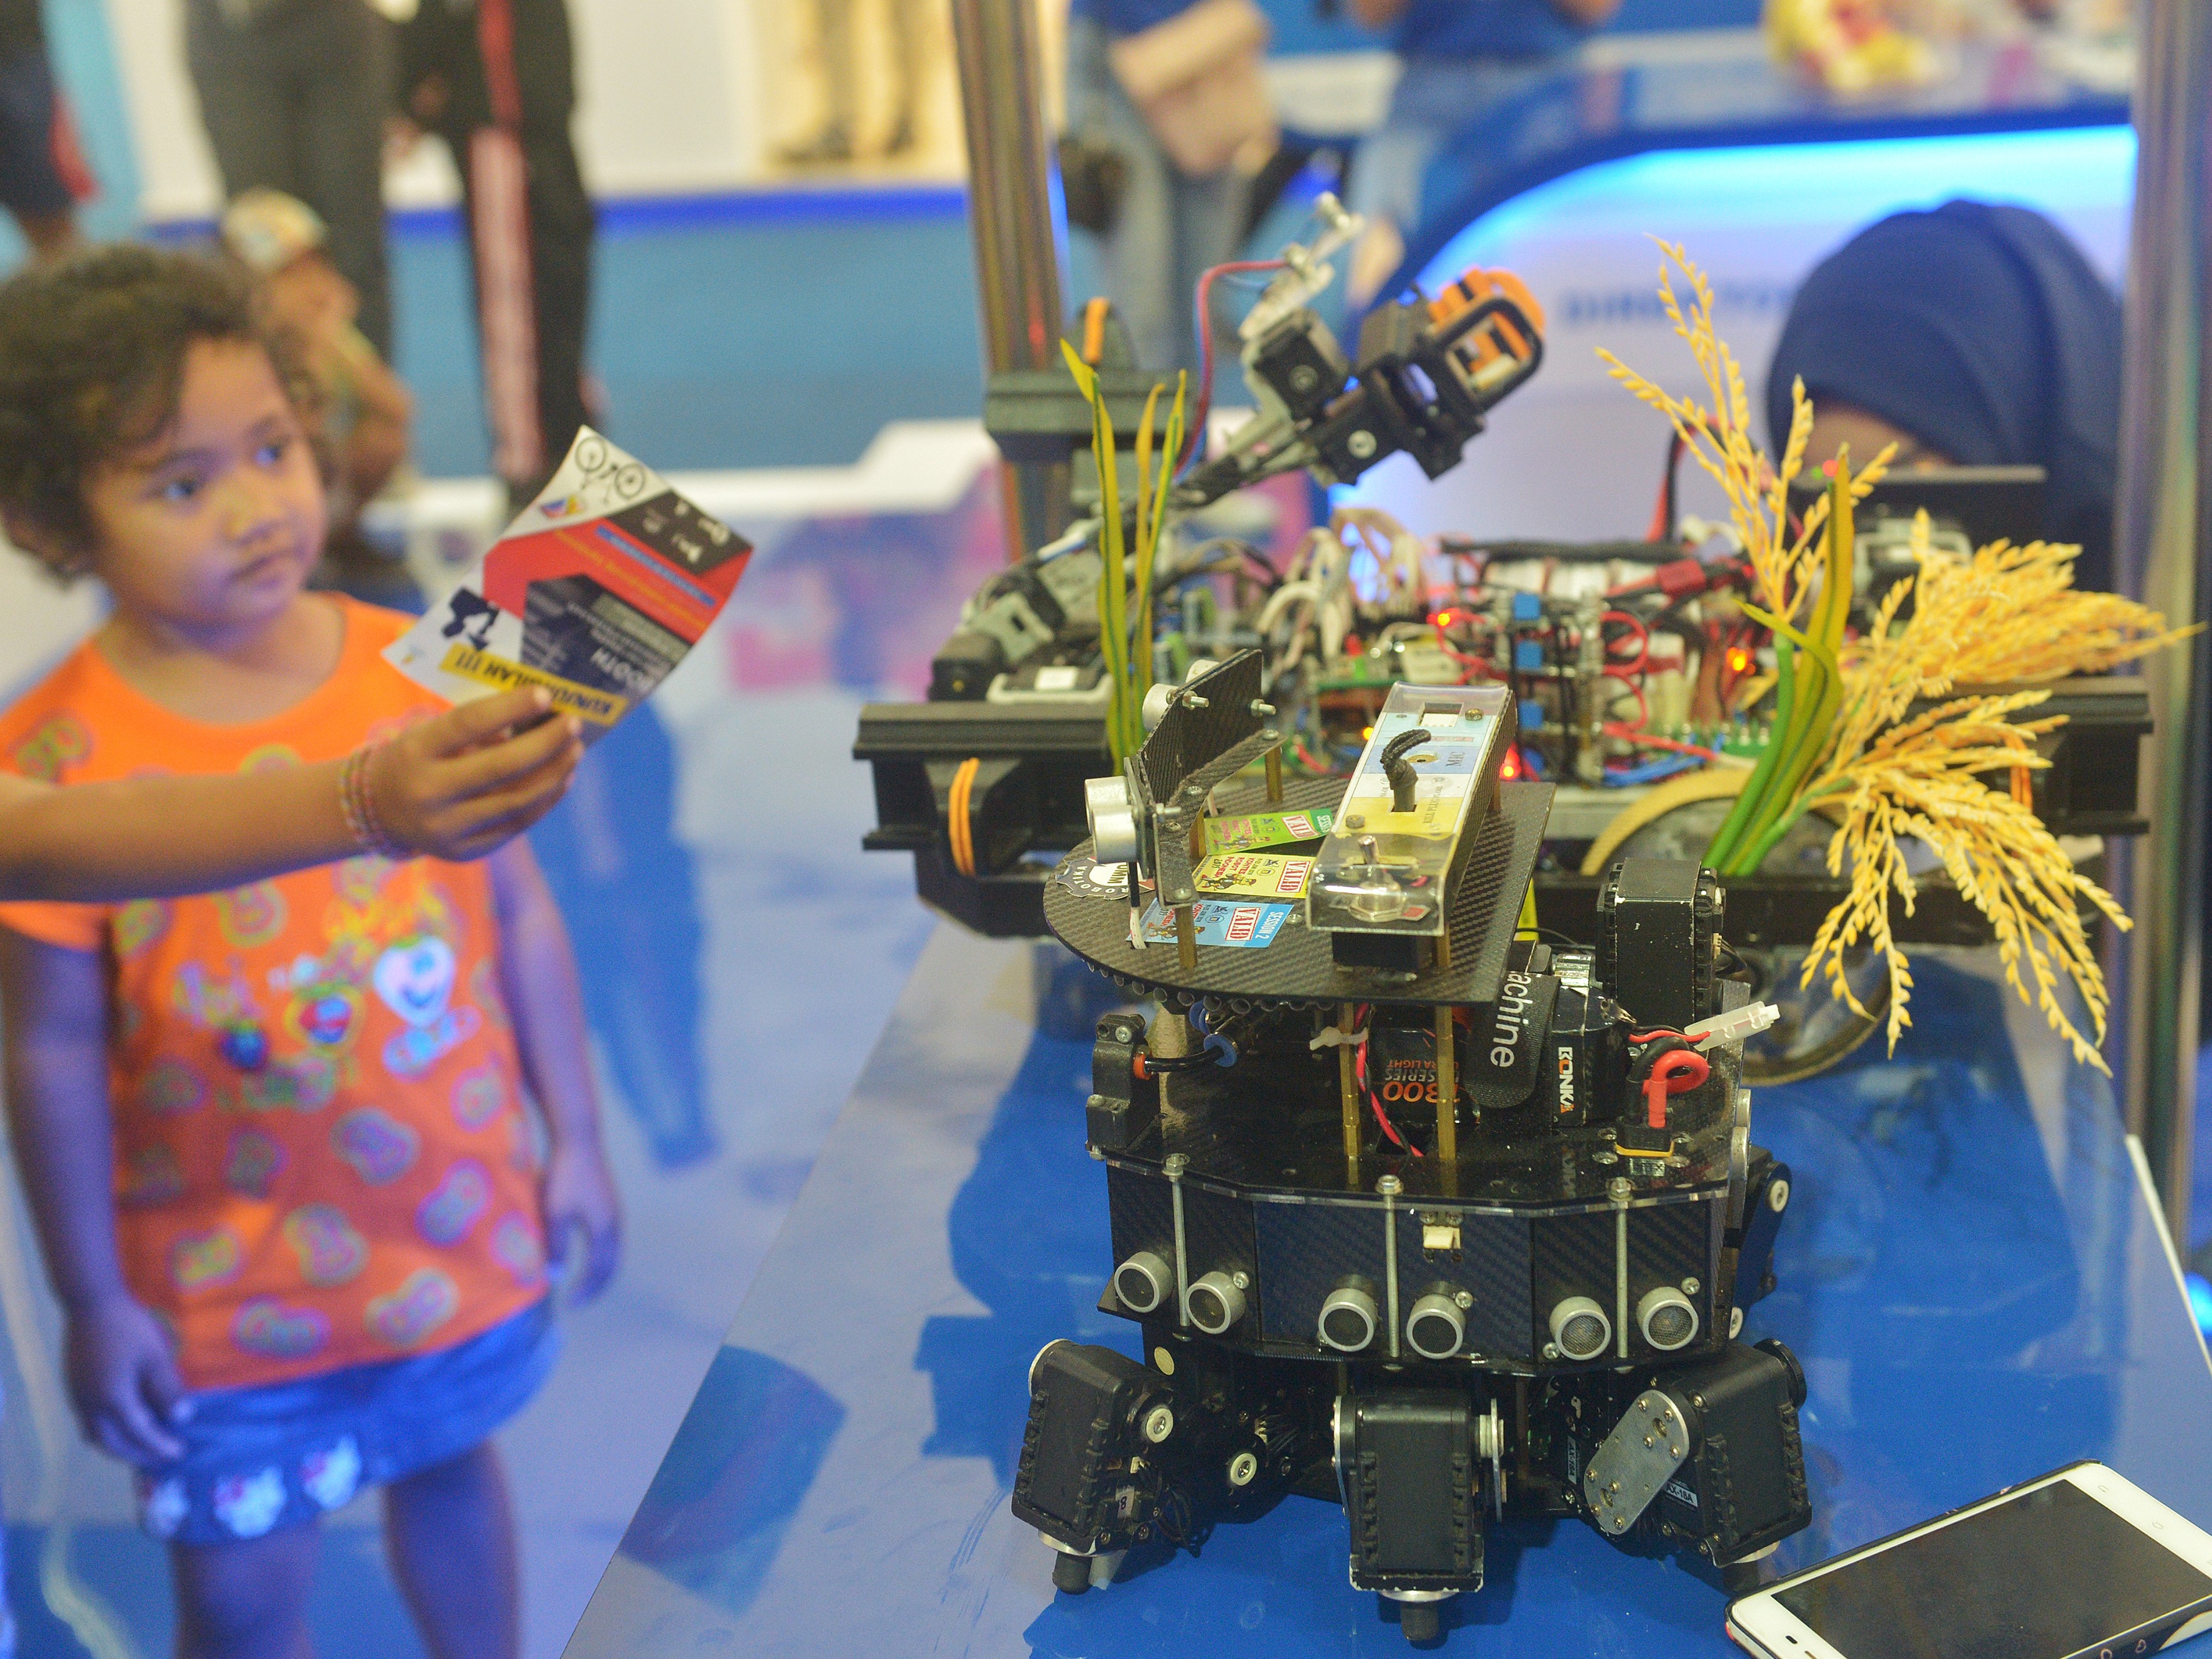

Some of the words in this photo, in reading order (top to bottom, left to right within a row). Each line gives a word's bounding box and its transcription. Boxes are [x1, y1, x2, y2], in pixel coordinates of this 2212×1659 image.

[1446, 751, 1465, 767] MIC
[1214, 856, 1234, 878] INDONESIA
[1230, 857, 1245, 871] ROBOT
[1238, 858, 1255, 874] KONTES
[1072, 866, 1129, 894] ROBOTIKA
[1280, 862, 1307, 891] VALID
[1193, 904, 1205, 920] KONT
[1230, 908, 1253, 939] VALID
[1260, 911, 1284, 935] SESSION
[1255, 932, 1270, 940] 2
[1490, 972, 1533, 1068] achine
[1387, 1060, 1422, 1068] LIGHT
[1385, 1068, 1435, 1082] SERIES
